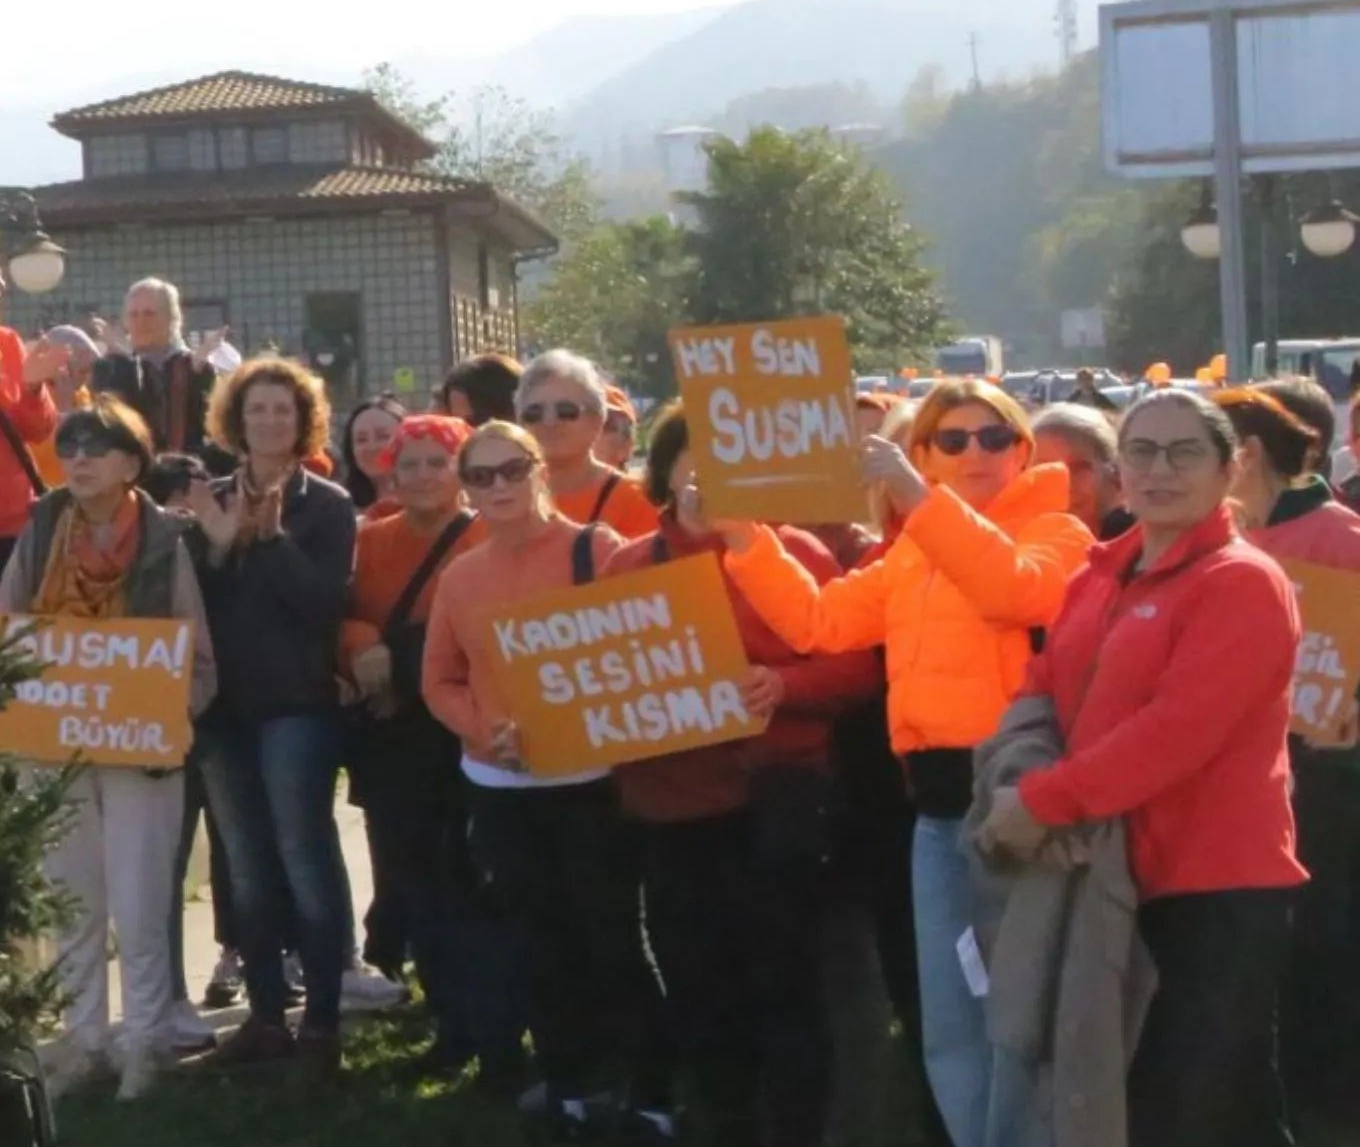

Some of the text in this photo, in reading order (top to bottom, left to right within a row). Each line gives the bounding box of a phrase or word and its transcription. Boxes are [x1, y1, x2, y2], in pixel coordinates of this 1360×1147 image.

[676, 327, 822, 378] HEY SEN
[492, 592, 673, 664] KADININ
[538, 623, 705, 704] SESİNİ
[59, 714, 174, 755] BÜYÜR
[583, 679, 750, 748] KISMA
